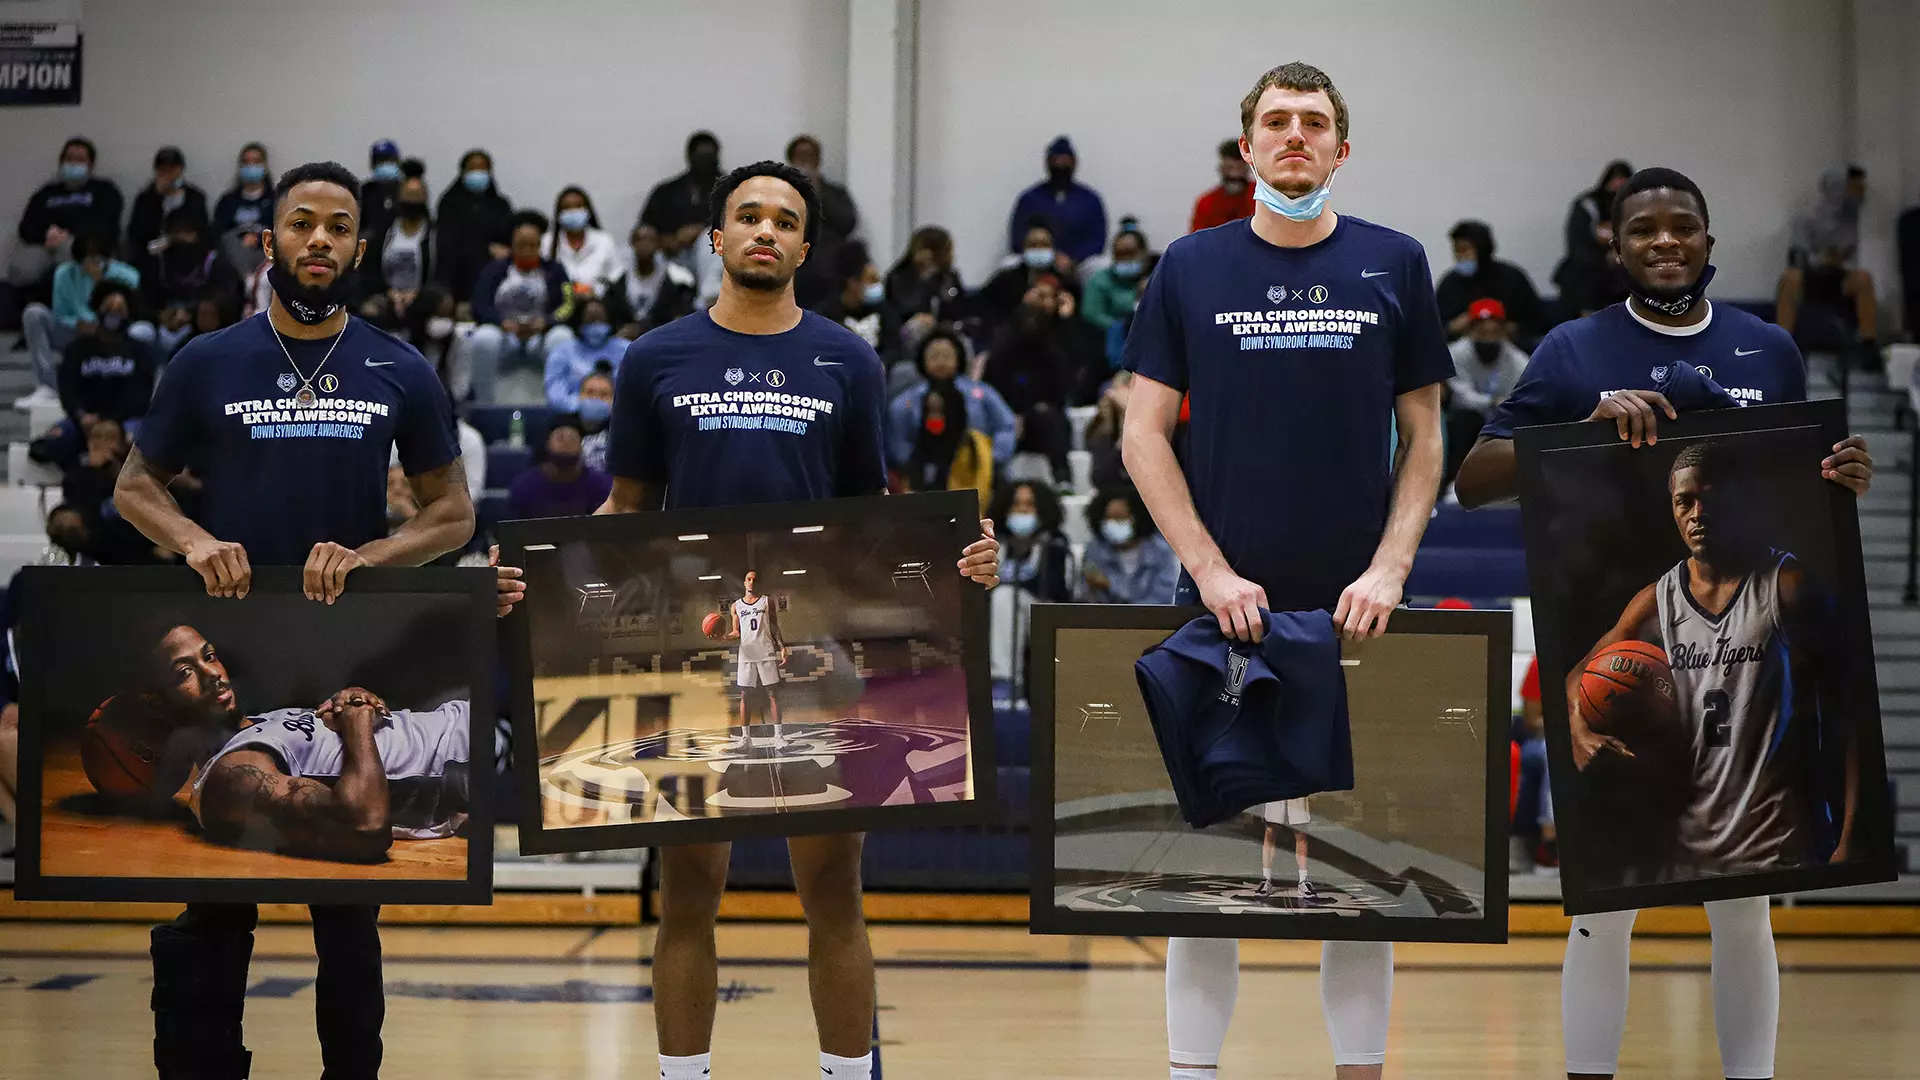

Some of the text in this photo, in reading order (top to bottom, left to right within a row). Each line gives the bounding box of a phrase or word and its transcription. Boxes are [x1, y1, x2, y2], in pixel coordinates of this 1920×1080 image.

[1215, 309, 1379, 325] EXTRA CHROMOSOME
[1232, 321, 1362, 336] EXTRA AWESOME
[1240, 334, 1354, 350] DOWN SYNDROME AWARENESS
[224, 398, 389, 417] EXTRA CHMOSOME
[673, 391, 834, 415] EXTRA CHROMOSOME
[690, 403, 817, 422] EXTRA AWESOME
[242, 410, 372, 425] EXTRA AWESOME
[698, 415, 808, 436] DOWN SYNDROME AWARENESS
[251, 423, 364, 440] DOWN SYNDROME AWARENESS
[750, 618, 758, 631] 0
[535, 635, 965, 692] INCOLN
[1669, 636, 1765, 678] Blue Tigers
[1702, 687, 1732, 748] 2
